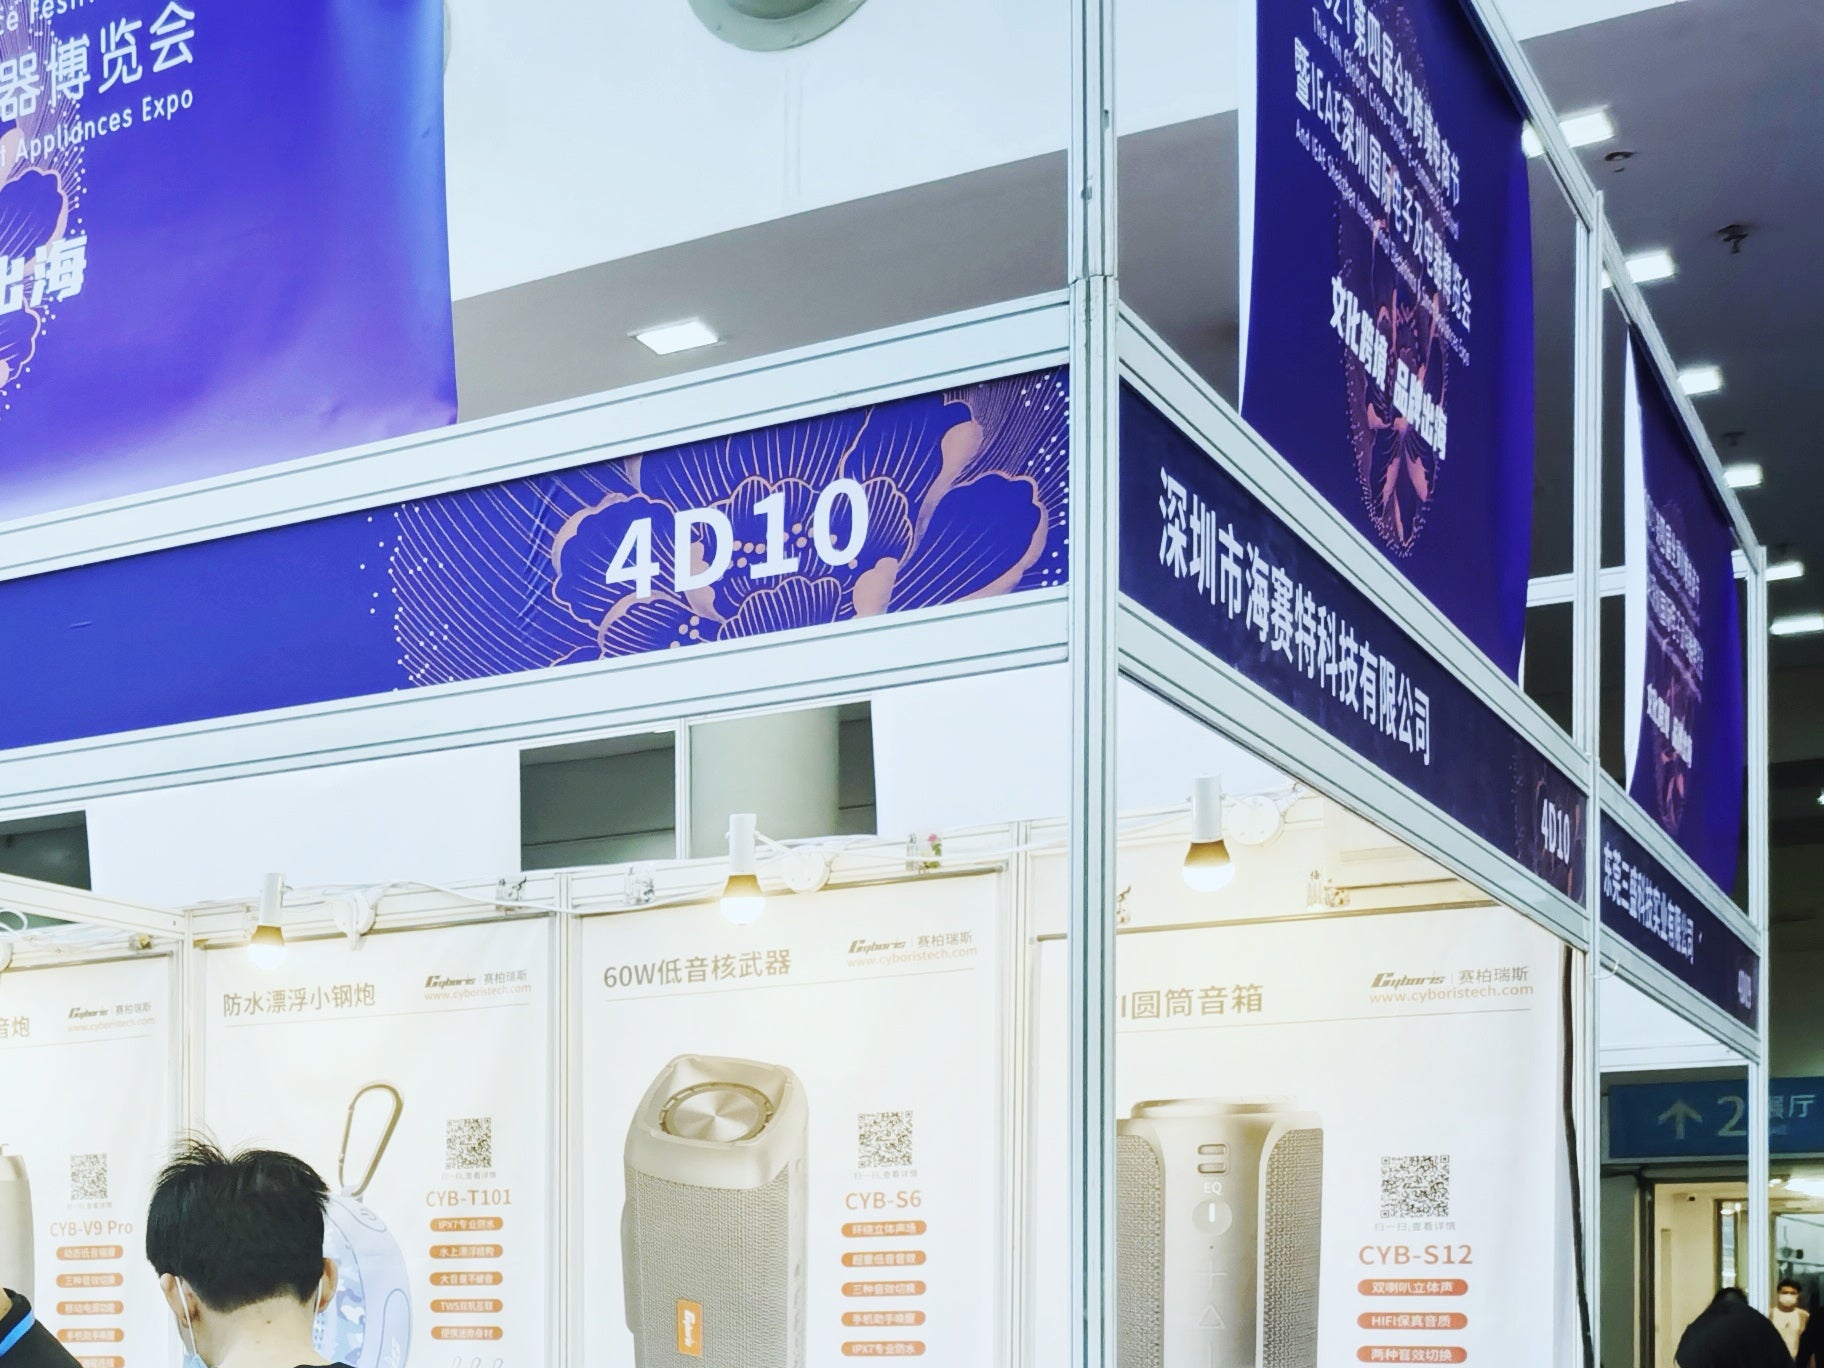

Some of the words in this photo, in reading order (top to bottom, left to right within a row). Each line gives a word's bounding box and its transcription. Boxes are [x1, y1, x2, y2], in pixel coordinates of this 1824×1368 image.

[1325, 0, 1460, 207] 21第四届全球跨境电商节
[14, 108, 134, 166] Appliances
[142, 89, 194, 126] Expo
[1330, 275, 1388, 393] 文化跨境
[1394, 357, 1448, 462] 品牌出海
[603, 476, 872, 604] 4D10
[1158, 464, 1432, 768] 深圳市海赛特科技有限公司
[1541, 796, 1572, 867] 4D10
[847, 937, 908, 955] Cyboris
[917, 930, 974, 949] 赛柏瑞斯
[846, 945, 979, 969] www.cyboristech.com
[603, 948, 793, 989] 60W低音核武器
[1459, 965, 1529, 985] 赛柏瑞斯
[1371, 971, 1446, 990] Cyboris
[222, 982, 376, 1018] 防水漂浮小钢炮
[424, 983, 532, 1003] www.cyboristech.com
[1117, 983, 1264, 1021] I圆筒音箱
[1369, 982, 1535, 1005] www.cyboristech.com
[1203, 1181, 1223, 1195] EQ
[425, 1190, 512, 1208] CYB-T101
[844, 1191, 923, 1212] CYB-S6
[50, 1220, 104, 1238] CYB-V9
[108, 1219, 134, 1236] Pro
[1358, 1244, 1474, 1266] CYB-S12
[1371, 1279, 1454, 1296] 双喇叭立体声
[1371, 1313, 1452, 1330] HIFI保真音质
[1370, 1346, 1453, 1363] 两种音效切换
